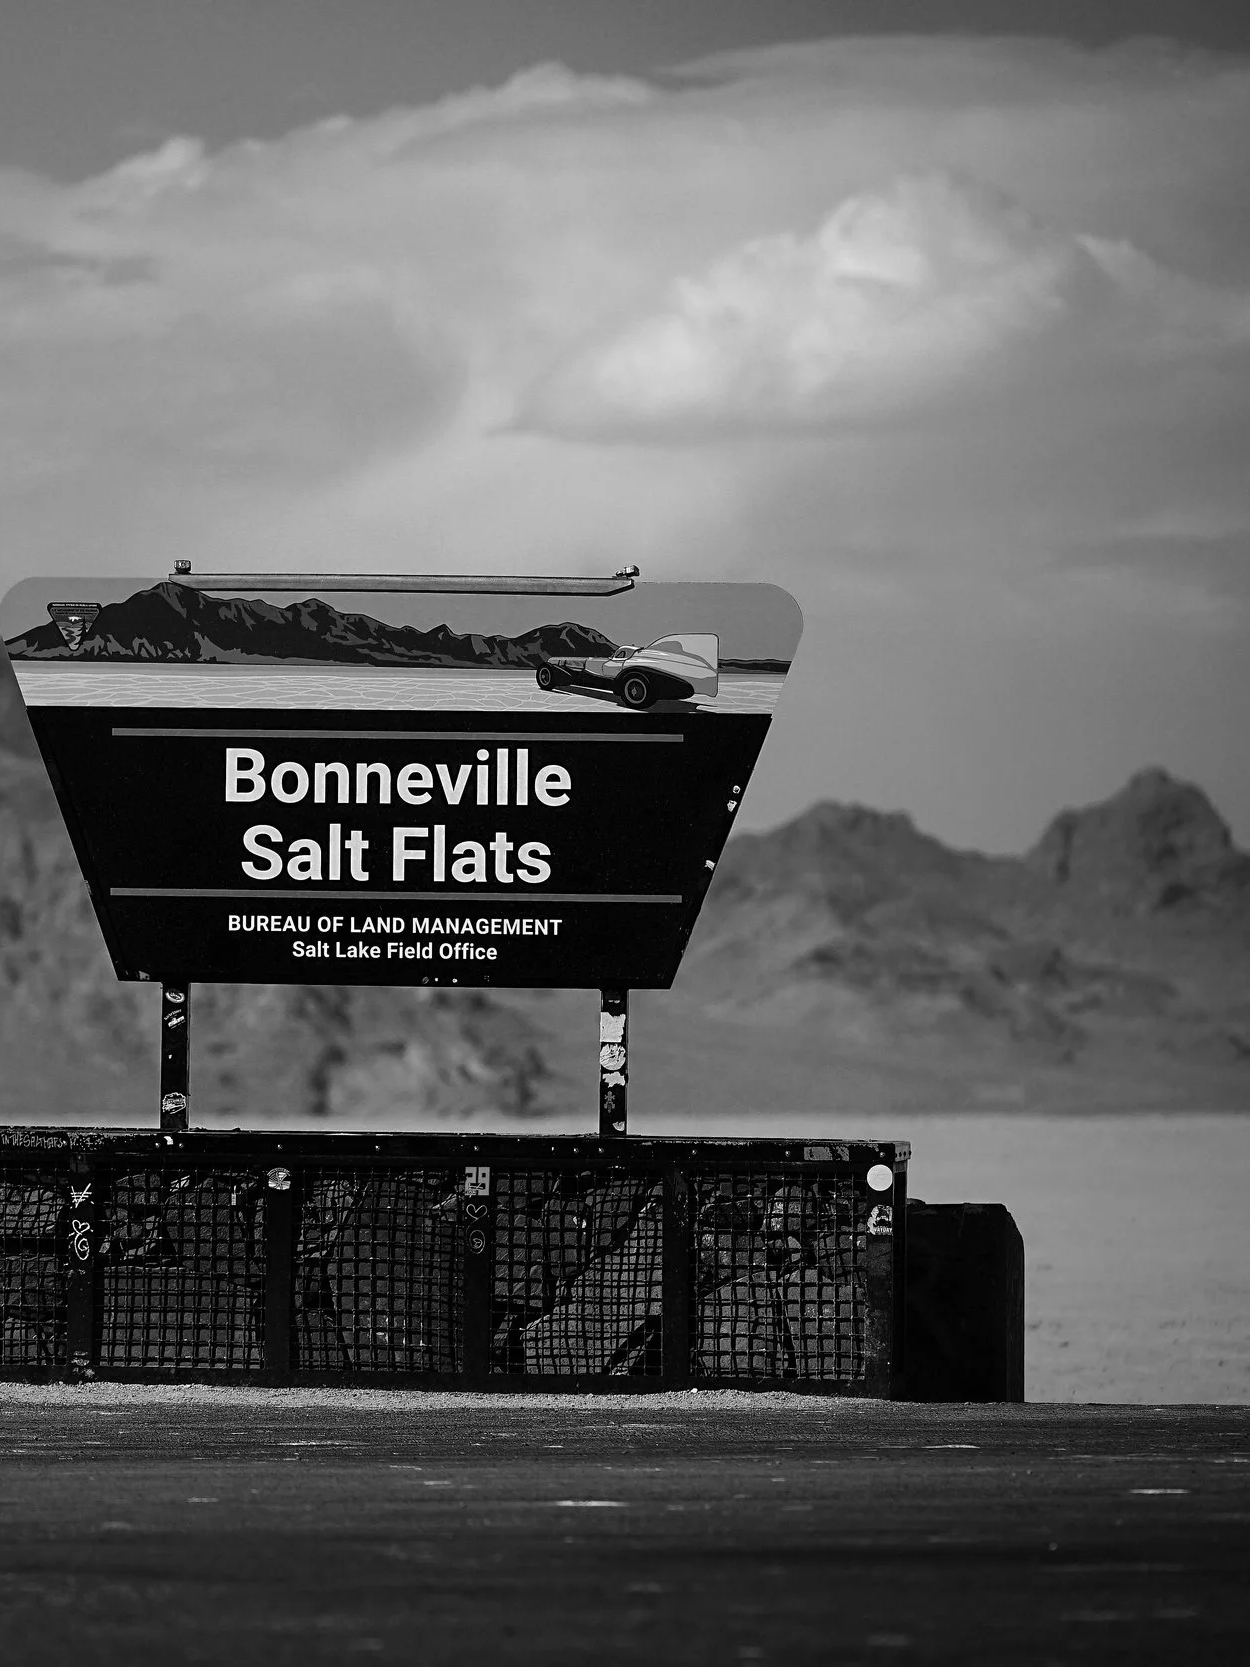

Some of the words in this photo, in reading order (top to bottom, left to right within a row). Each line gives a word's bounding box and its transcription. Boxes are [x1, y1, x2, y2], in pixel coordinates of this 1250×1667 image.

[225, 747, 572, 807] Bonneville
[241, 823, 370, 882] Salt
[392, 824, 552, 884] Flats
[228, 914, 311, 933] BUREAU
[317, 915, 344, 934] OF
[350, 916, 406, 935] LAND
[412, 917, 563, 936] MANAGEMENT
[292, 940, 330, 959] Salt
[335, 940, 382, 959] Lake
[387, 941, 433, 960] Field
[438, 942, 498, 961] Office
